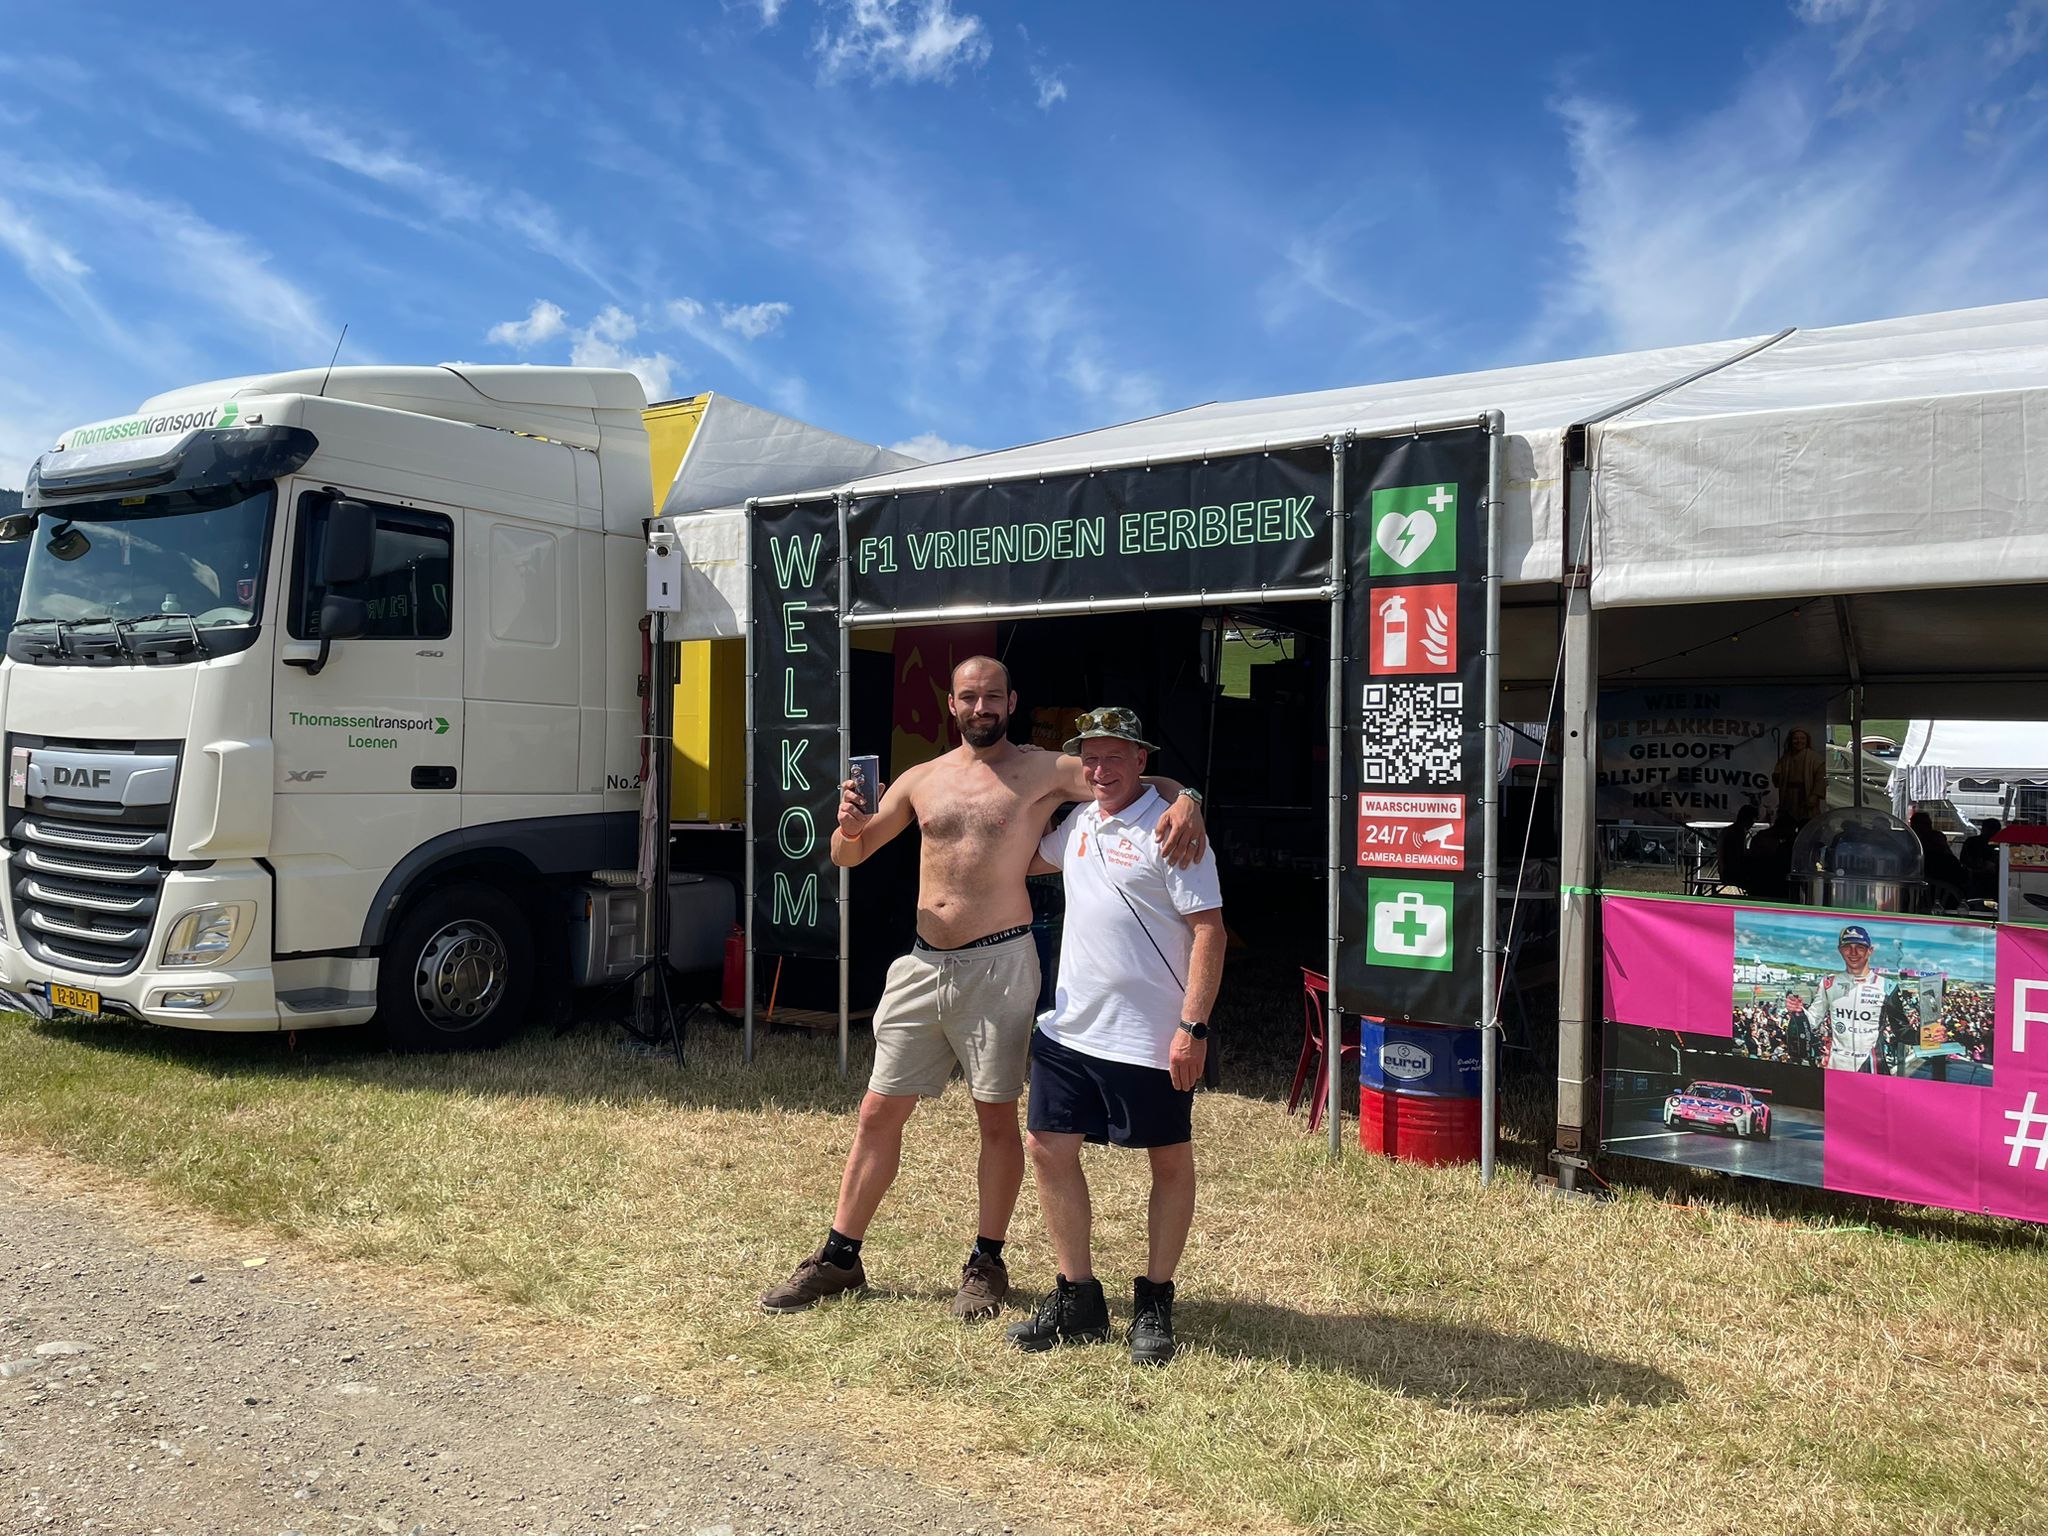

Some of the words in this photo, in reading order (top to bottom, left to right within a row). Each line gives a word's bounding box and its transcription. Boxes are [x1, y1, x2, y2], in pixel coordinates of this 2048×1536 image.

[71, 406, 218, 449] Thomassentransport
[858, 535, 898, 575] F1
[907, 516, 1105, 571] VRIENDEN
[1119, 495, 1315, 555] EERBEEK
[416, 650, 444, 658] 450
[1644, 692, 1687, 710] WIE
[1694, 693, 1720, 710] IN
[289, 712, 433, 731] Thomassentransport
[770, 533, 822, 927] WELKOM
[1603, 720, 1630, 740] DE
[1637, 718, 1766, 739] PLAKKERIJ
[349, 735, 397, 749] Loenen
[1629, 742, 1734, 761] GELOOFT
[54, 767, 111, 788] DAF
[284, 770, 327, 782] XF
[1597, 767, 1670, 787] BLIJFT
[1677, 767, 1769, 789] EEUWIG
[1365, 801, 1457, 813] WAARSCHUWING
[1633, 791, 1728, 810] KLEVEN!
[1365, 825, 1409, 845] 24/7
[1361, 851, 1402, 863] CAMERA
[1405, 854, 1458, 865] BEWAKING
[975, 927, 1022, 948] ORIGINAL
[57, 987, 94, 1010] 12-BLZ-1
[1836, 1008, 1871, 1021] HYLO
[1383, 1055, 1427, 1069] eurol
